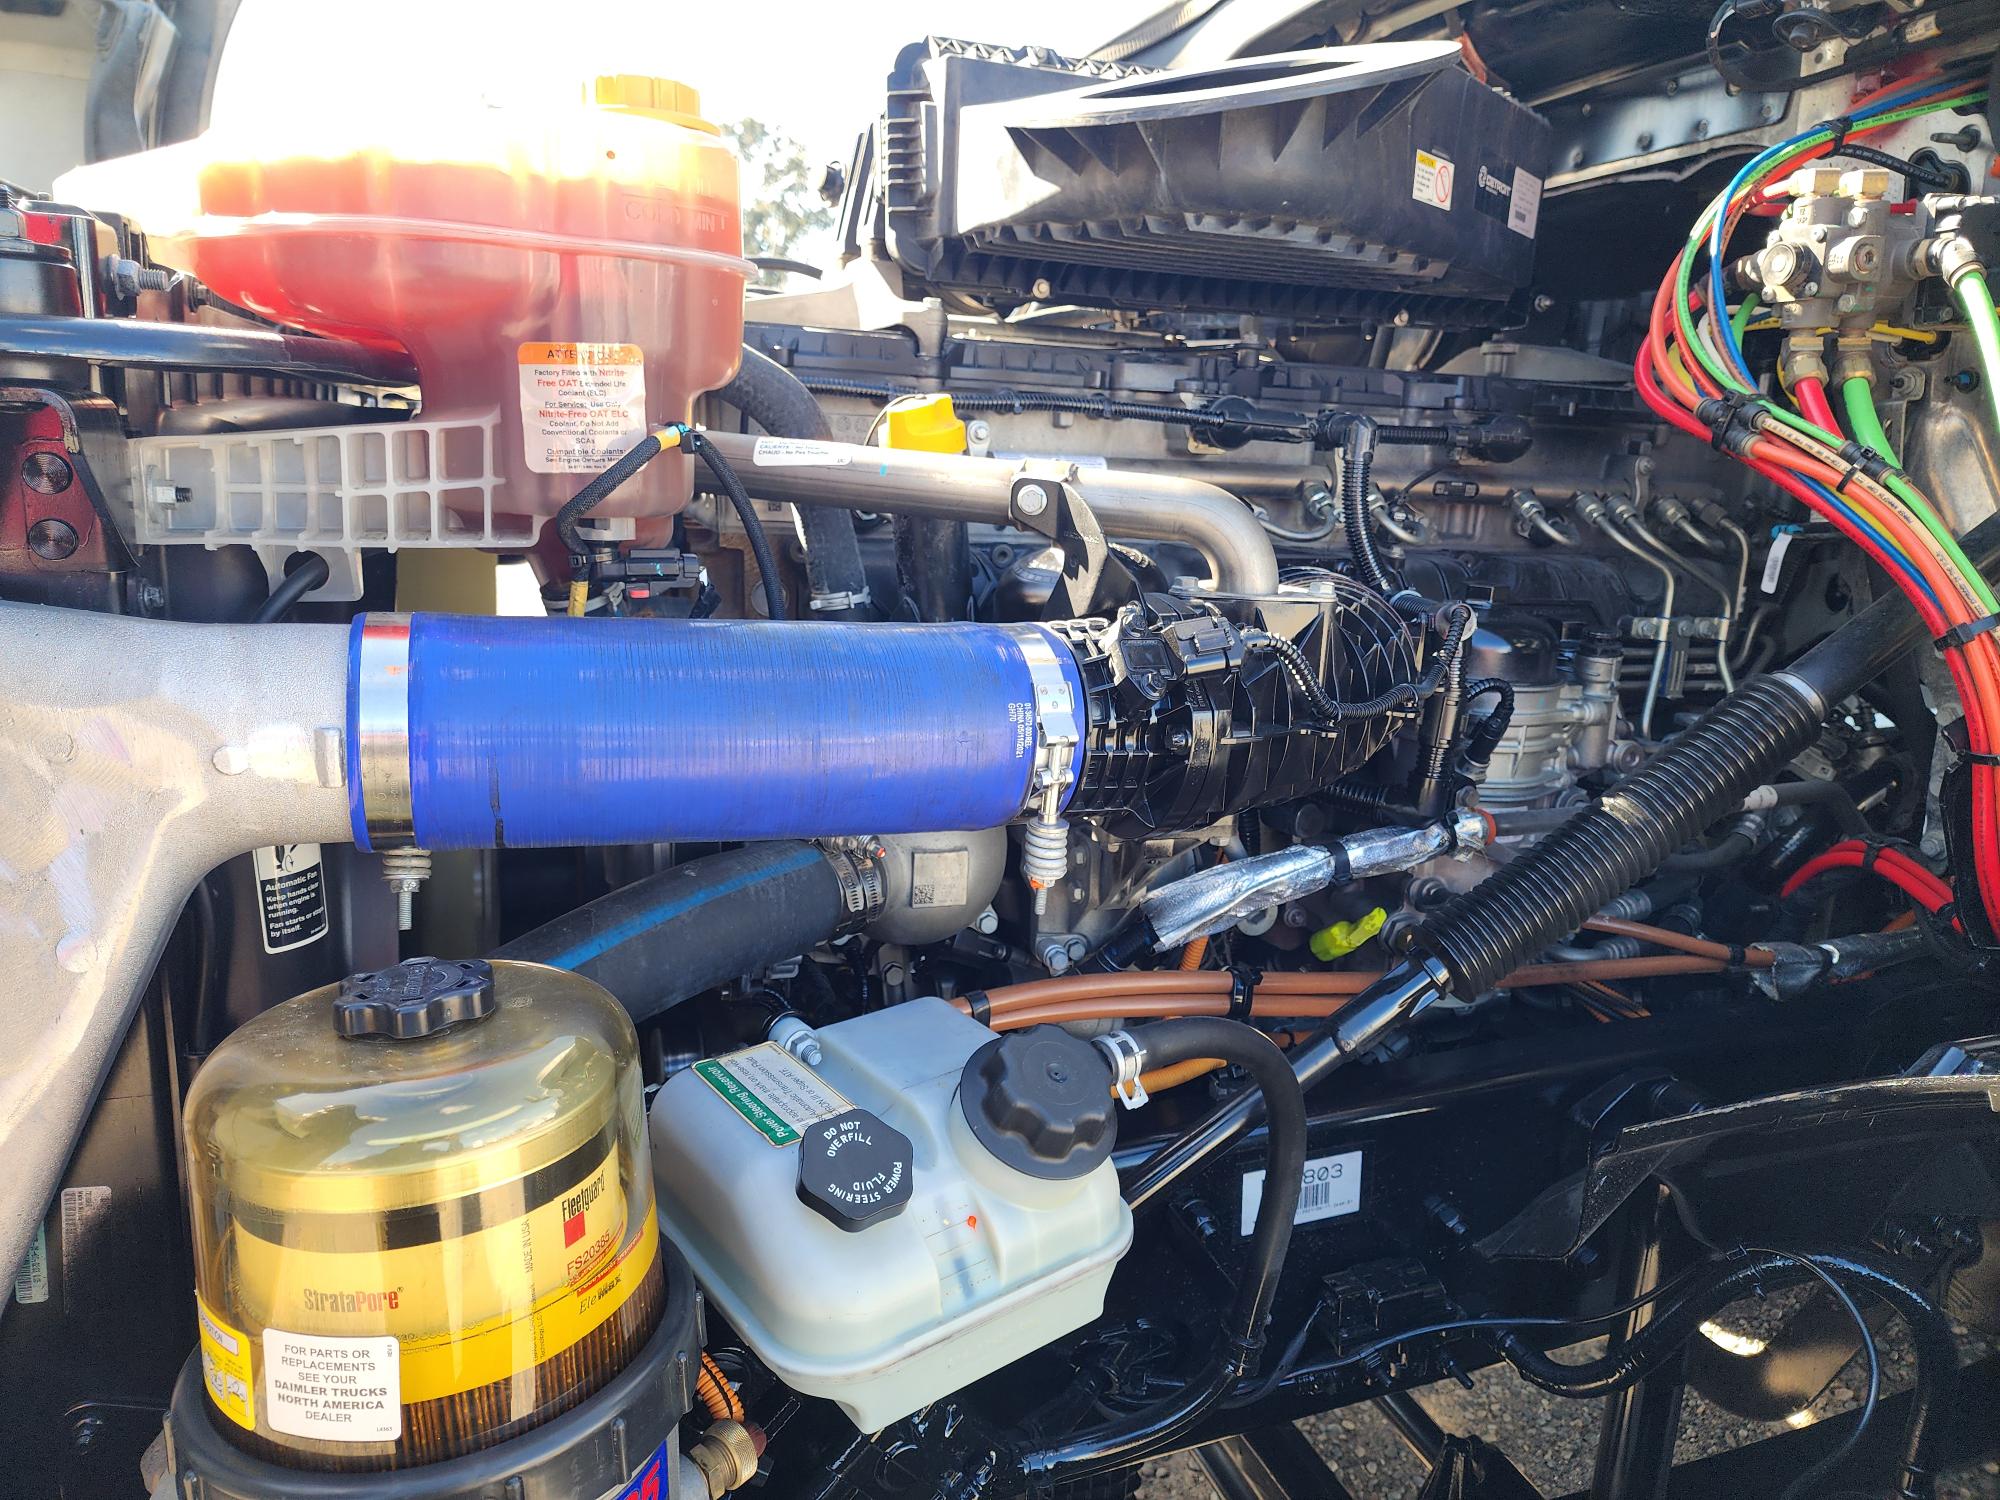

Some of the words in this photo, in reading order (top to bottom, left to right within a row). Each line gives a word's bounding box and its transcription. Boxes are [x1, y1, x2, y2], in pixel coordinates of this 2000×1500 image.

[537, 379, 556, 387] Free
[559, 379, 577, 387] OAT
[590, 410, 608, 418] OAT
[611, 410, 629, 418] ELC
[1008, 702, 1016, 722] GH70
[1016, 702, 1024, 723] CHINA
[1015, 723, 1025, 758] 05/11/2021
[265, 875, 307, 892] Automatic
[306, 870, 318, 880] Fan
[266, 892, 287, 903] Keep
[287, 886, 307, 898] hands
[267, 901, 288, 911] when
[288, 894, 310, 905] engine
[268, 907, 299, 919] running.
[269, 920, 284, 930] Fan
[285, 915, 305, 926] starts
[305, 911, 312, 919] or
[270, 929, 281, 938] by
[281, 924, 302, 935] itself.
[707, 1066, 741, 1094] Reservoir
[737, 1091, 767, 1122] Steering
[764, 1116, 787, 1138] Power
[823, 1127, 837, 1140] DO
[839, 1121, 861, 1132] NOT
[826, 1132, 872, 1158] OVERFILL
[853, 1172, 886, 1191] FLUID
[883, 1161, 903, 1194] POWER
[1303, 1163, 1343, 1184] 803
[561, 1170, 606, 1223] Fleetguard
[827, 1183, 881, 1204] STEERING
[520, 1218, 531, 1238] USA
[566, 1228, 610, 1276] FS20385
[523, 1252, 534, 1275] MADE
[303, 1288, 399, 1313] StrataPore
[284, 1344, 307, 1356] FOR
[310, 1348, 348, 1359] PARTS
[352, 1350, 370, 1359] OR
[281, 1356, 376, 1372] REPLACEMENTS
[274, 1380, 328, 1396] DAIMLER
[331, 1387, 388, 1397] TRUCKS
[298, 1372, 320, 1383] SEE
[323, 1375, 357, 1385] YOUR
[277, 1393, 319, 1408] NORTH
[322, 1400, 385, 1410] AMERICA
[305, 1410, 352, 1423] DEALER
